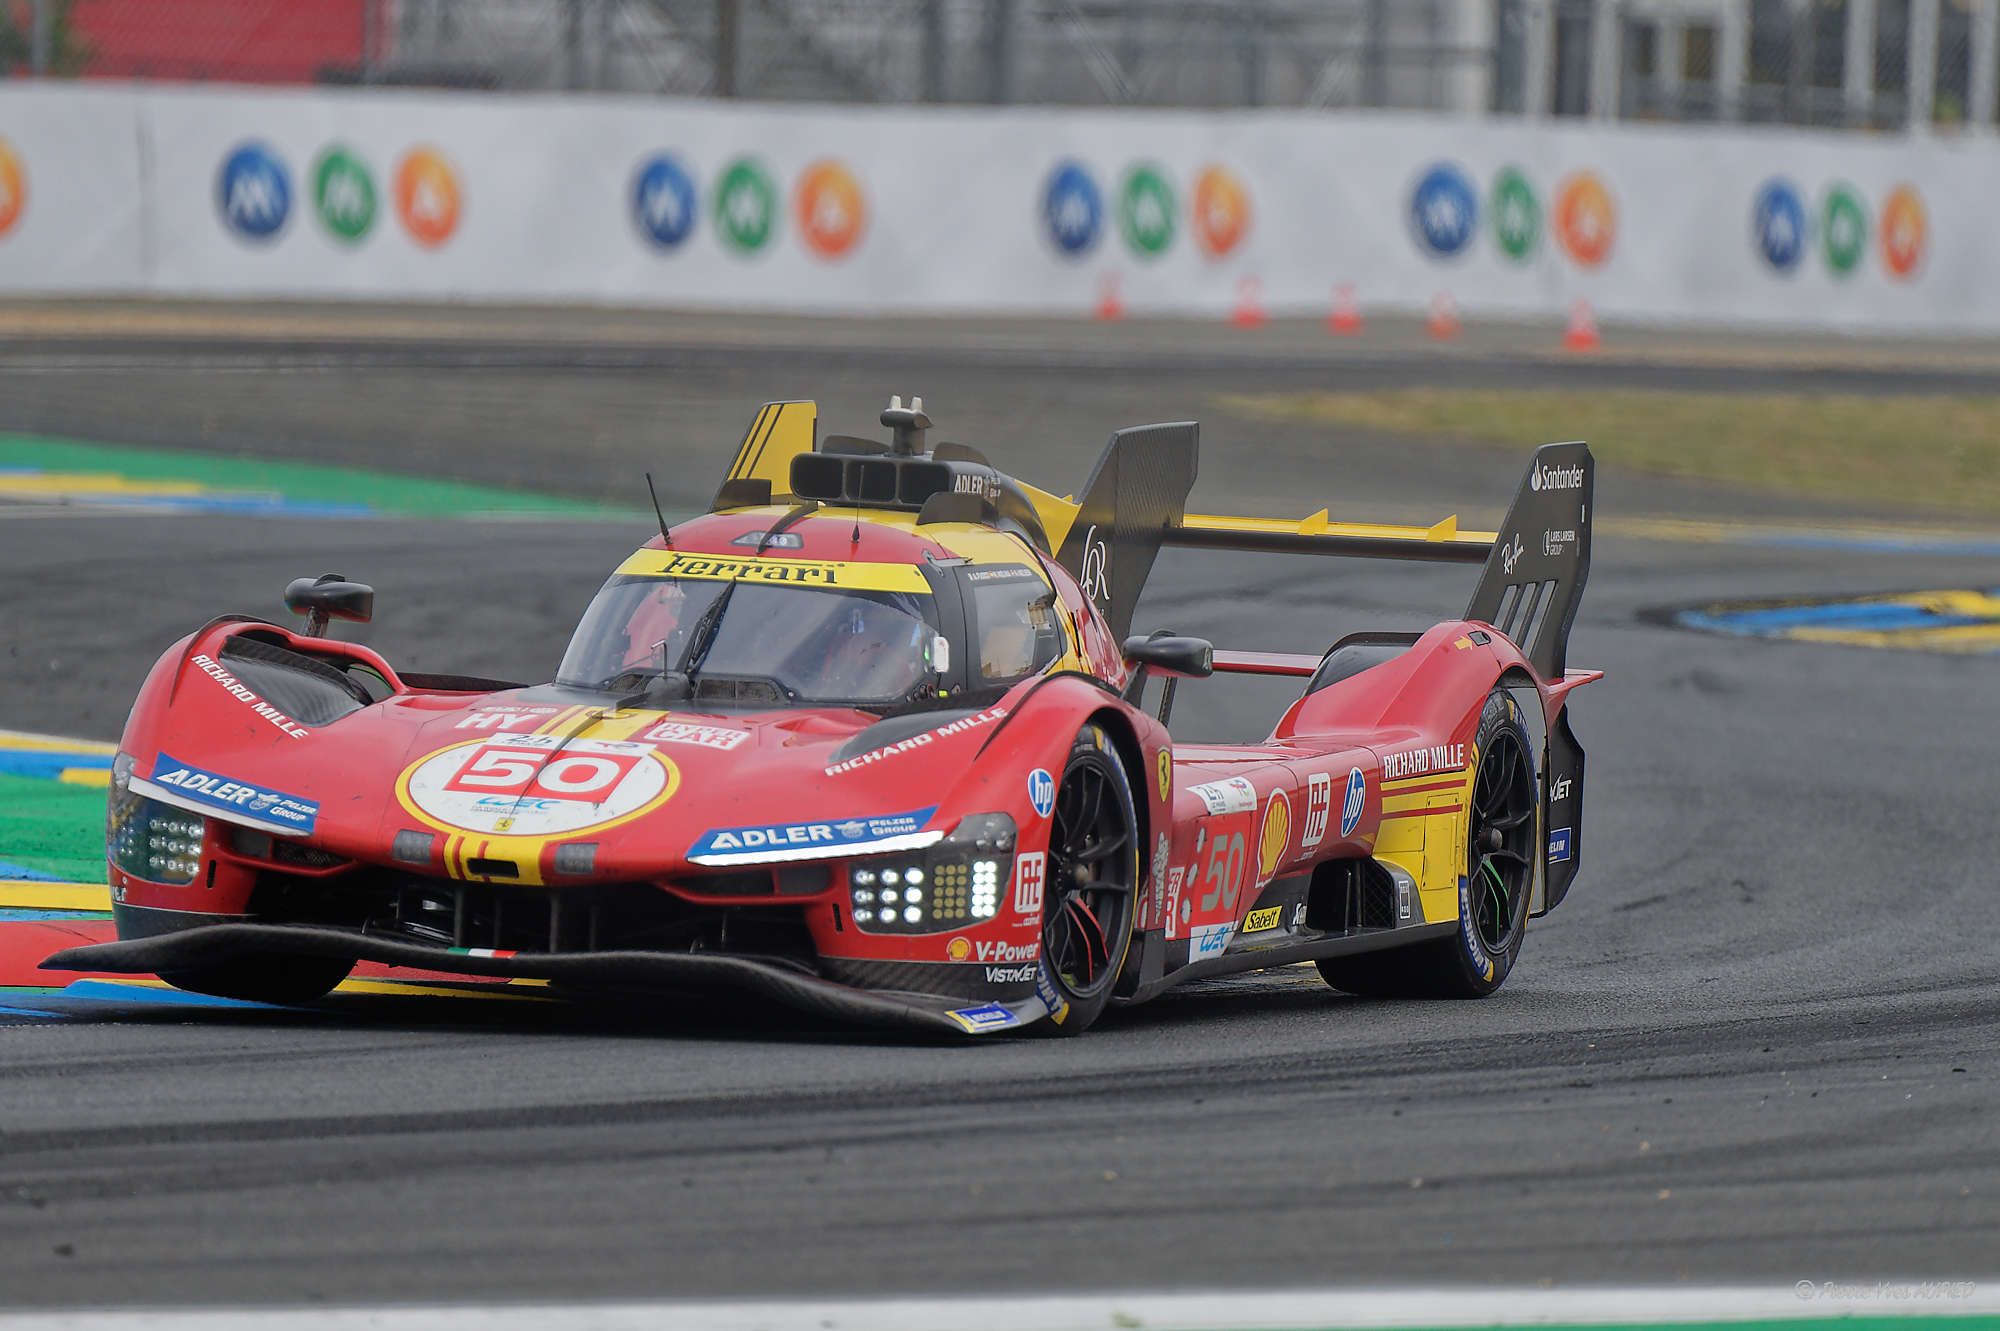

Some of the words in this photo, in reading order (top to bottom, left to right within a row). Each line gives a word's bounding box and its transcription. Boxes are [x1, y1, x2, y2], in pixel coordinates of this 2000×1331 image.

[953, 474, 983, 495] ADLER
[1541, 463, 1584, 490] Santander
[656, 552, 842, 585] Ferrari
[191, 655, 257, 702] RICHARD
[251, 701, 309, 739] MILLE
[455, 713, 538, 729] HY
[653, 729, 734, 747] CAR
[825, 733, 932, 776] RICHARD
[936, 707, 1007, 737] MILLE
[458, 749, 621, 793] 50
[1383, 749, 1429, 779] RICHARD
[1430, 743, 1464, 770] MILLE
[157, 768, 256, 805] ADLER
[1033, 770, 1052, 816] hp
[270, 806, 307, 821] GROUP
[1344, 769, 1364, 836] hp
[865, 817, 915, 828] PELZER
[871, 825, 917, 836] GROUP
[710, 825, 834, 849] ADLER
[1200, 832, 1245, 912] 50
[1248, 910, 1277, 930] Sabelt
[975, 940, 1039, 961] V-Power
